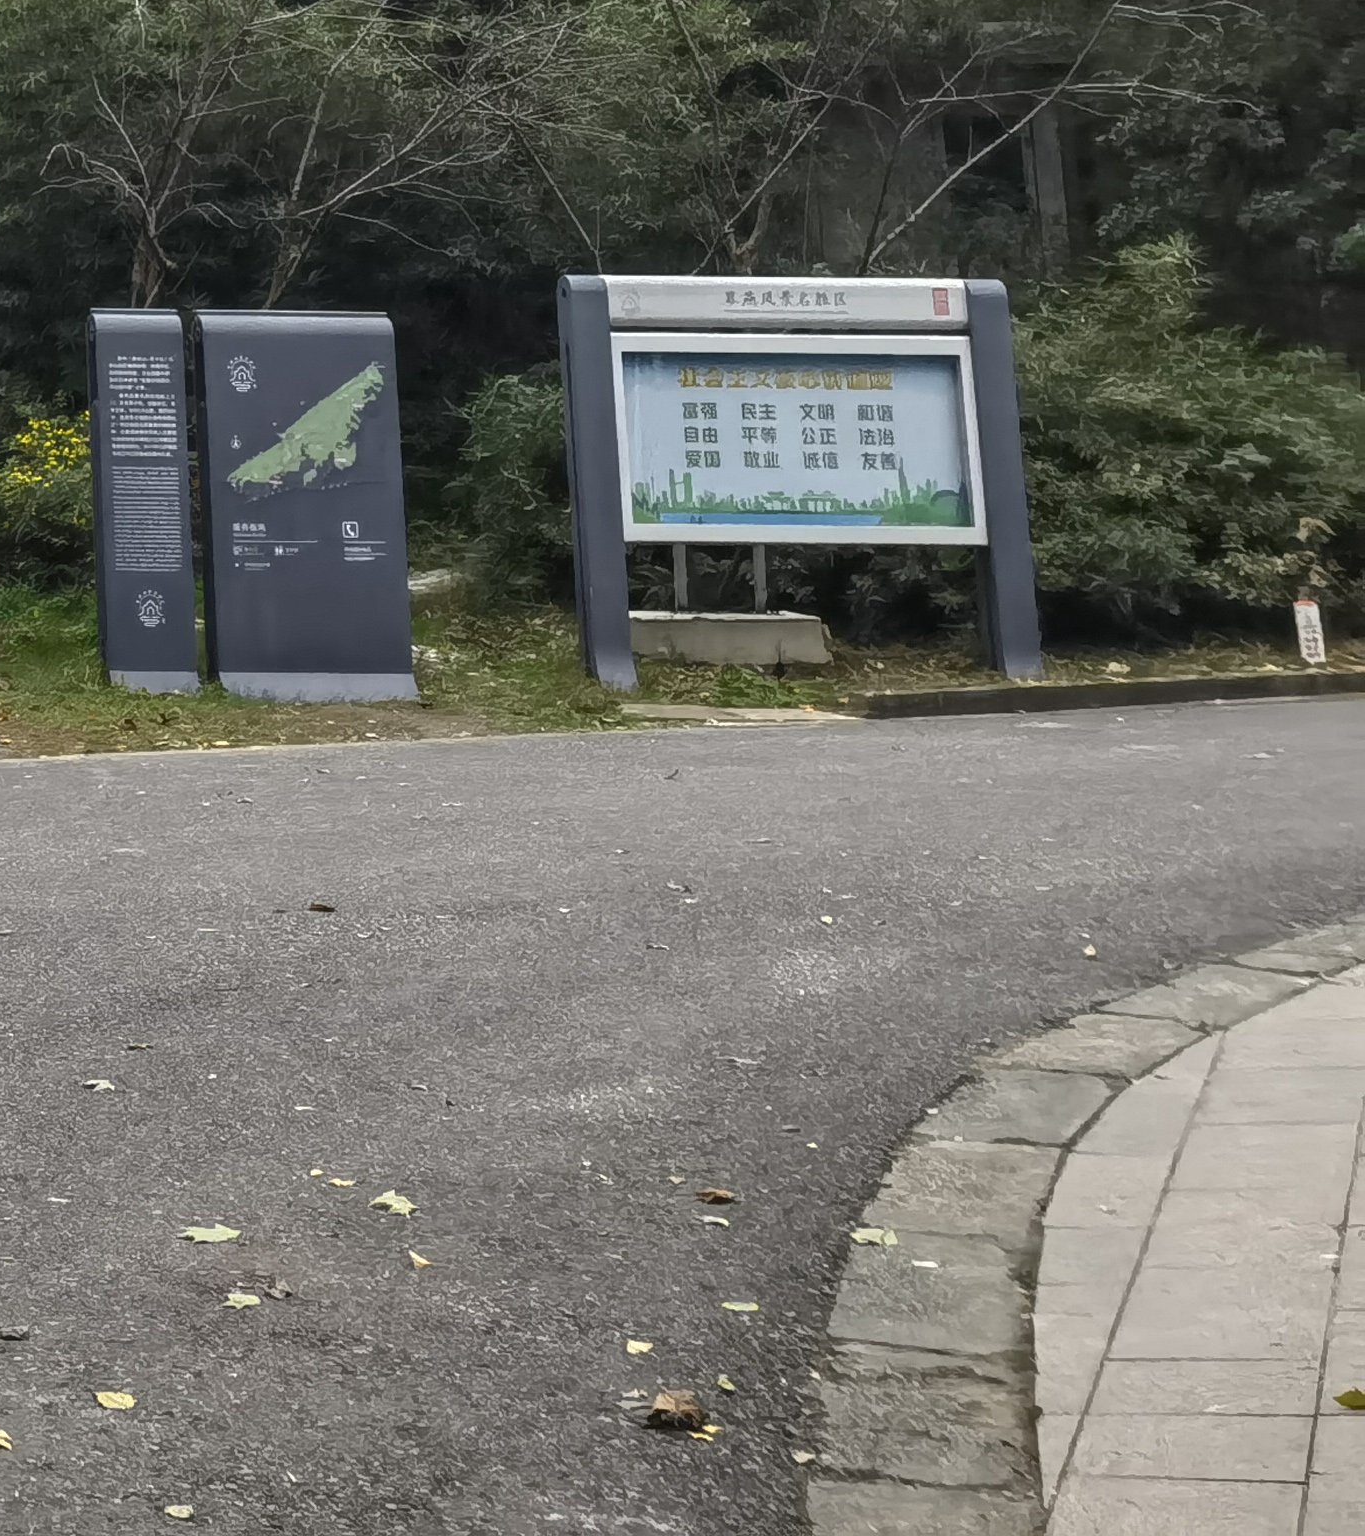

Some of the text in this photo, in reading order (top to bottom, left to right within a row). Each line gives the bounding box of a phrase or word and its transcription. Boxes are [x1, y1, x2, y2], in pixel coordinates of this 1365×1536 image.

[682, 402, 894, 422] 富强 民主 文明 和谐
[684, 426, 895, 446] 自由 平等 公正 法治
[685, 450, 898, 470] 爱国 敬业 诚信 友善
